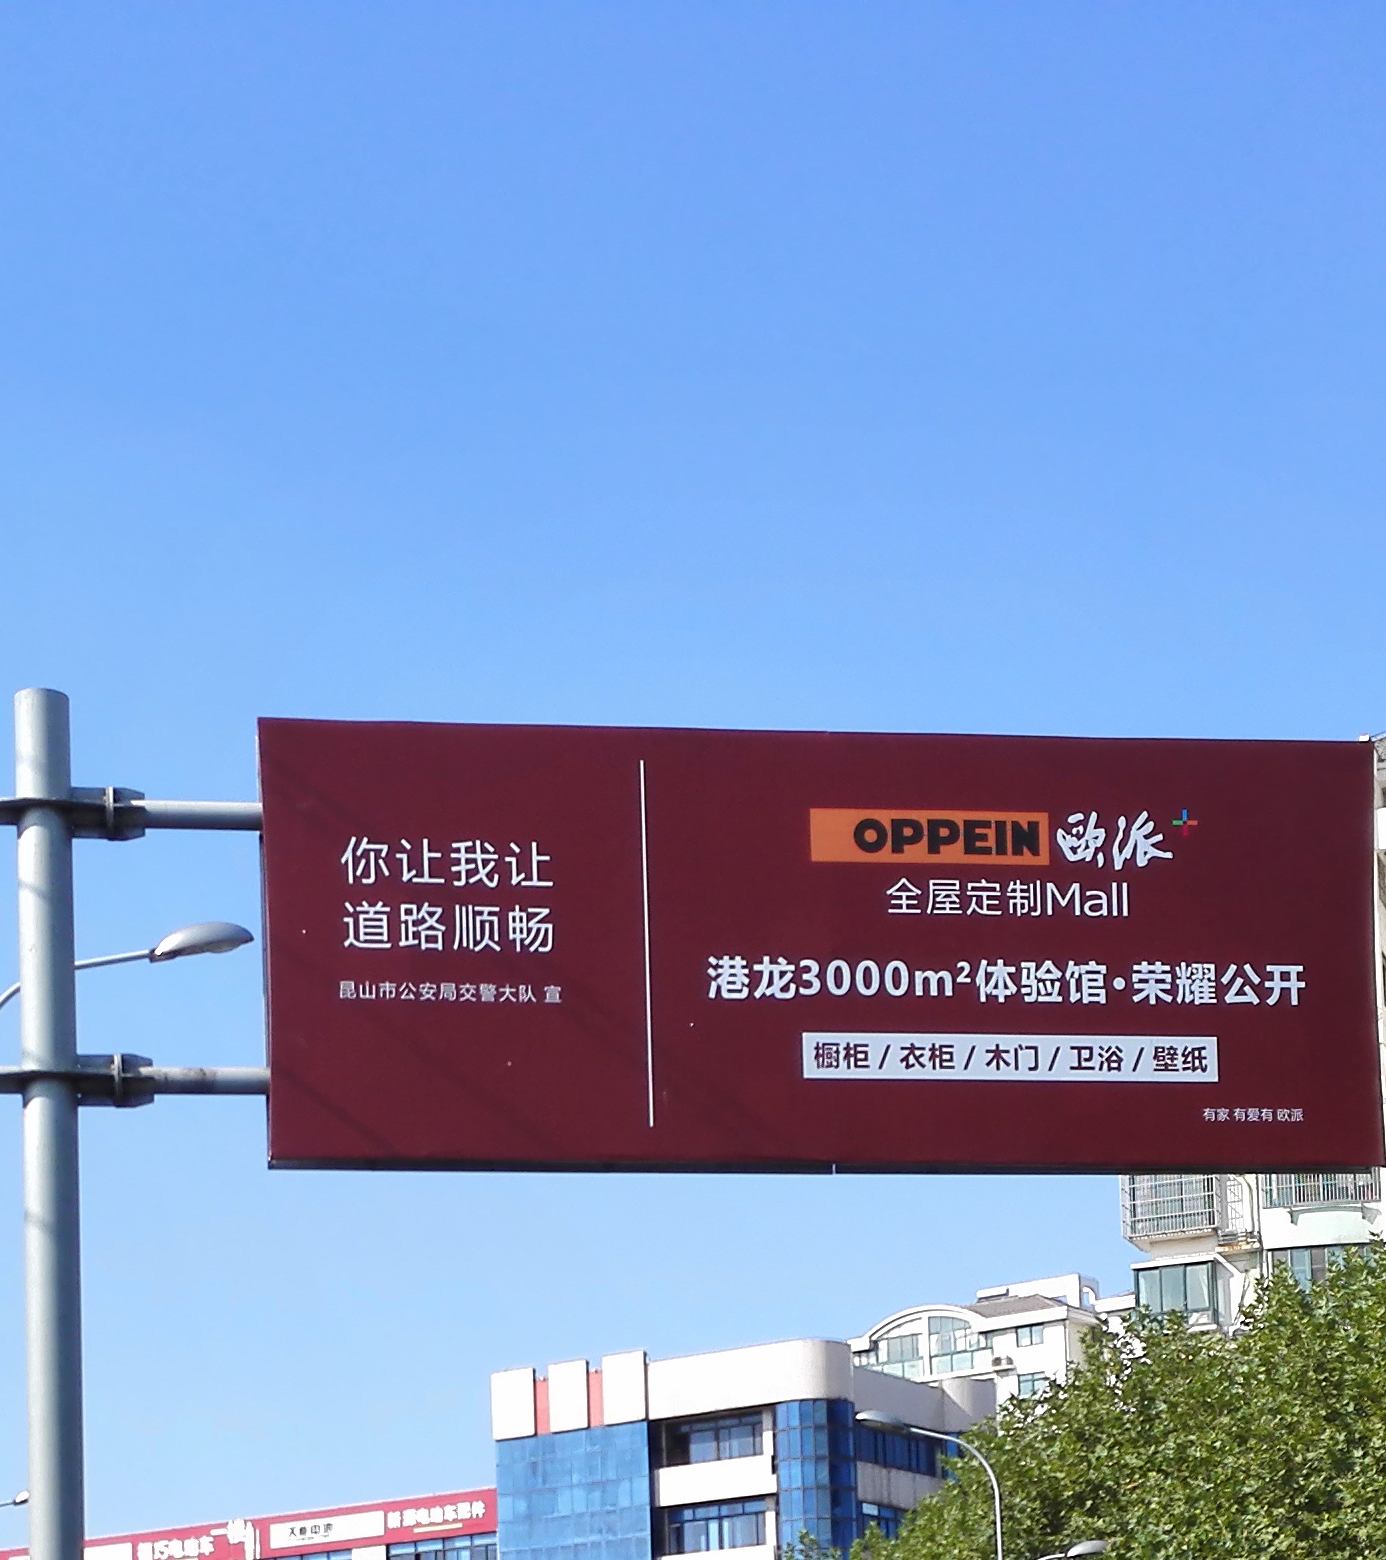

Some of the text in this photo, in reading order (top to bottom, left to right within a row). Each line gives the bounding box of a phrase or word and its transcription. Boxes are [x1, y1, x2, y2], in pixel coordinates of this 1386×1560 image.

[340, 835, 554, 889] 你让我让
[852, 818, 1041, 857] OPPEIN
[1056, 809, 1173, 870] 欧派
[886, 877, 1130, 918] 全屋定制Mall
[342, 900, 554, 954] 道路顺畅
